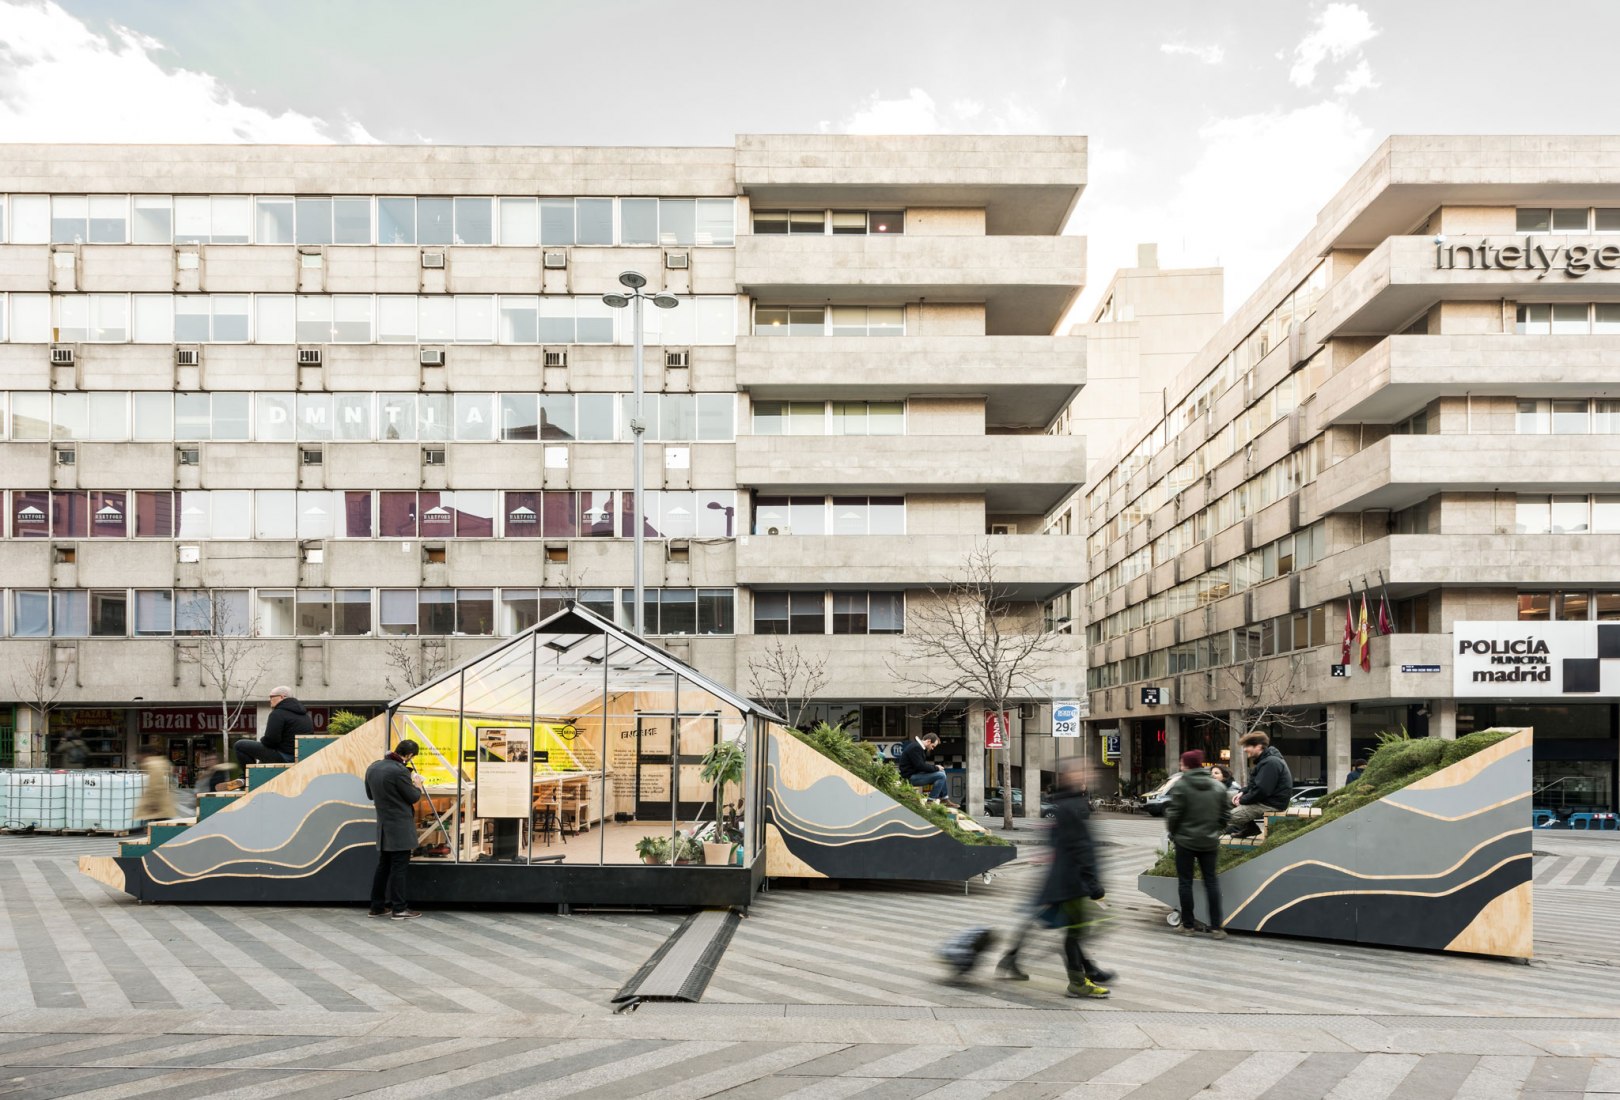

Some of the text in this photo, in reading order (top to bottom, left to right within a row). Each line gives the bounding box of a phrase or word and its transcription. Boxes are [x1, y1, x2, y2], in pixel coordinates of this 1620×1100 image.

[1459, 635, 1550, 655] POLICÍA
[1490, 655, 1551, 665] MUNICIPAL
[1472, 665, 1551, 682] madrid
[142, 711, 194, 729] Bazar
[1055, 722, 1070, 732] 29
[1108, 736, 1119, 751] P
